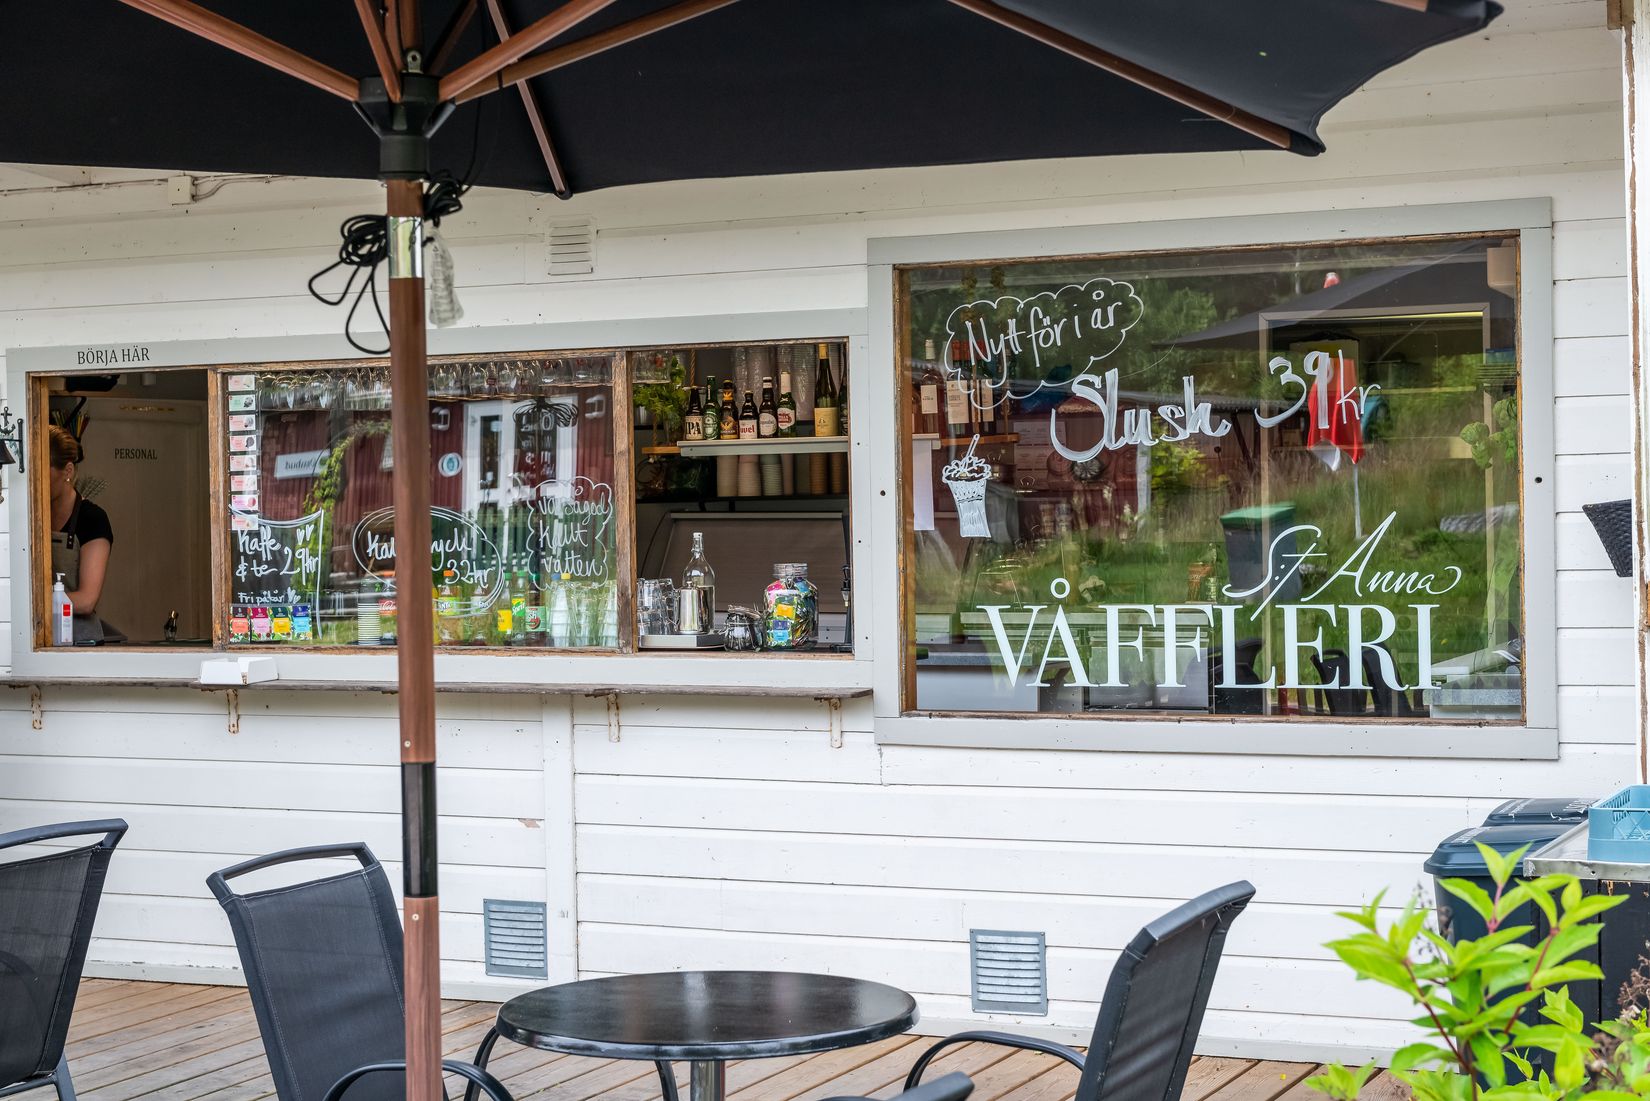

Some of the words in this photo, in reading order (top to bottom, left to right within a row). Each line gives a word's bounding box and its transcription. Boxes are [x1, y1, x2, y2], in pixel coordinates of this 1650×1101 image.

[77, 347, 118, 367] BÖRJA
[121, 345, 150, 362] HÄR
[965, 316, 1026, 388] Nytt
[1026, 306, 1068, 368] för
[1073, 303, 1082, 339] i
[1091, 290, 1123, 330] år
[740, 424, 755, 434] uvel
[1050, 367, 1232, 463] Slush
[114, 447, 158, 460] PERSONAL
[431, 527, 472, 572] ryck
[543, 550, 603, 577] vatten
[1300, 511, 1462, 602] Anna
[250, 559, 278, 577] te
[976, 577, 1442, 691] VÅFFLERI
